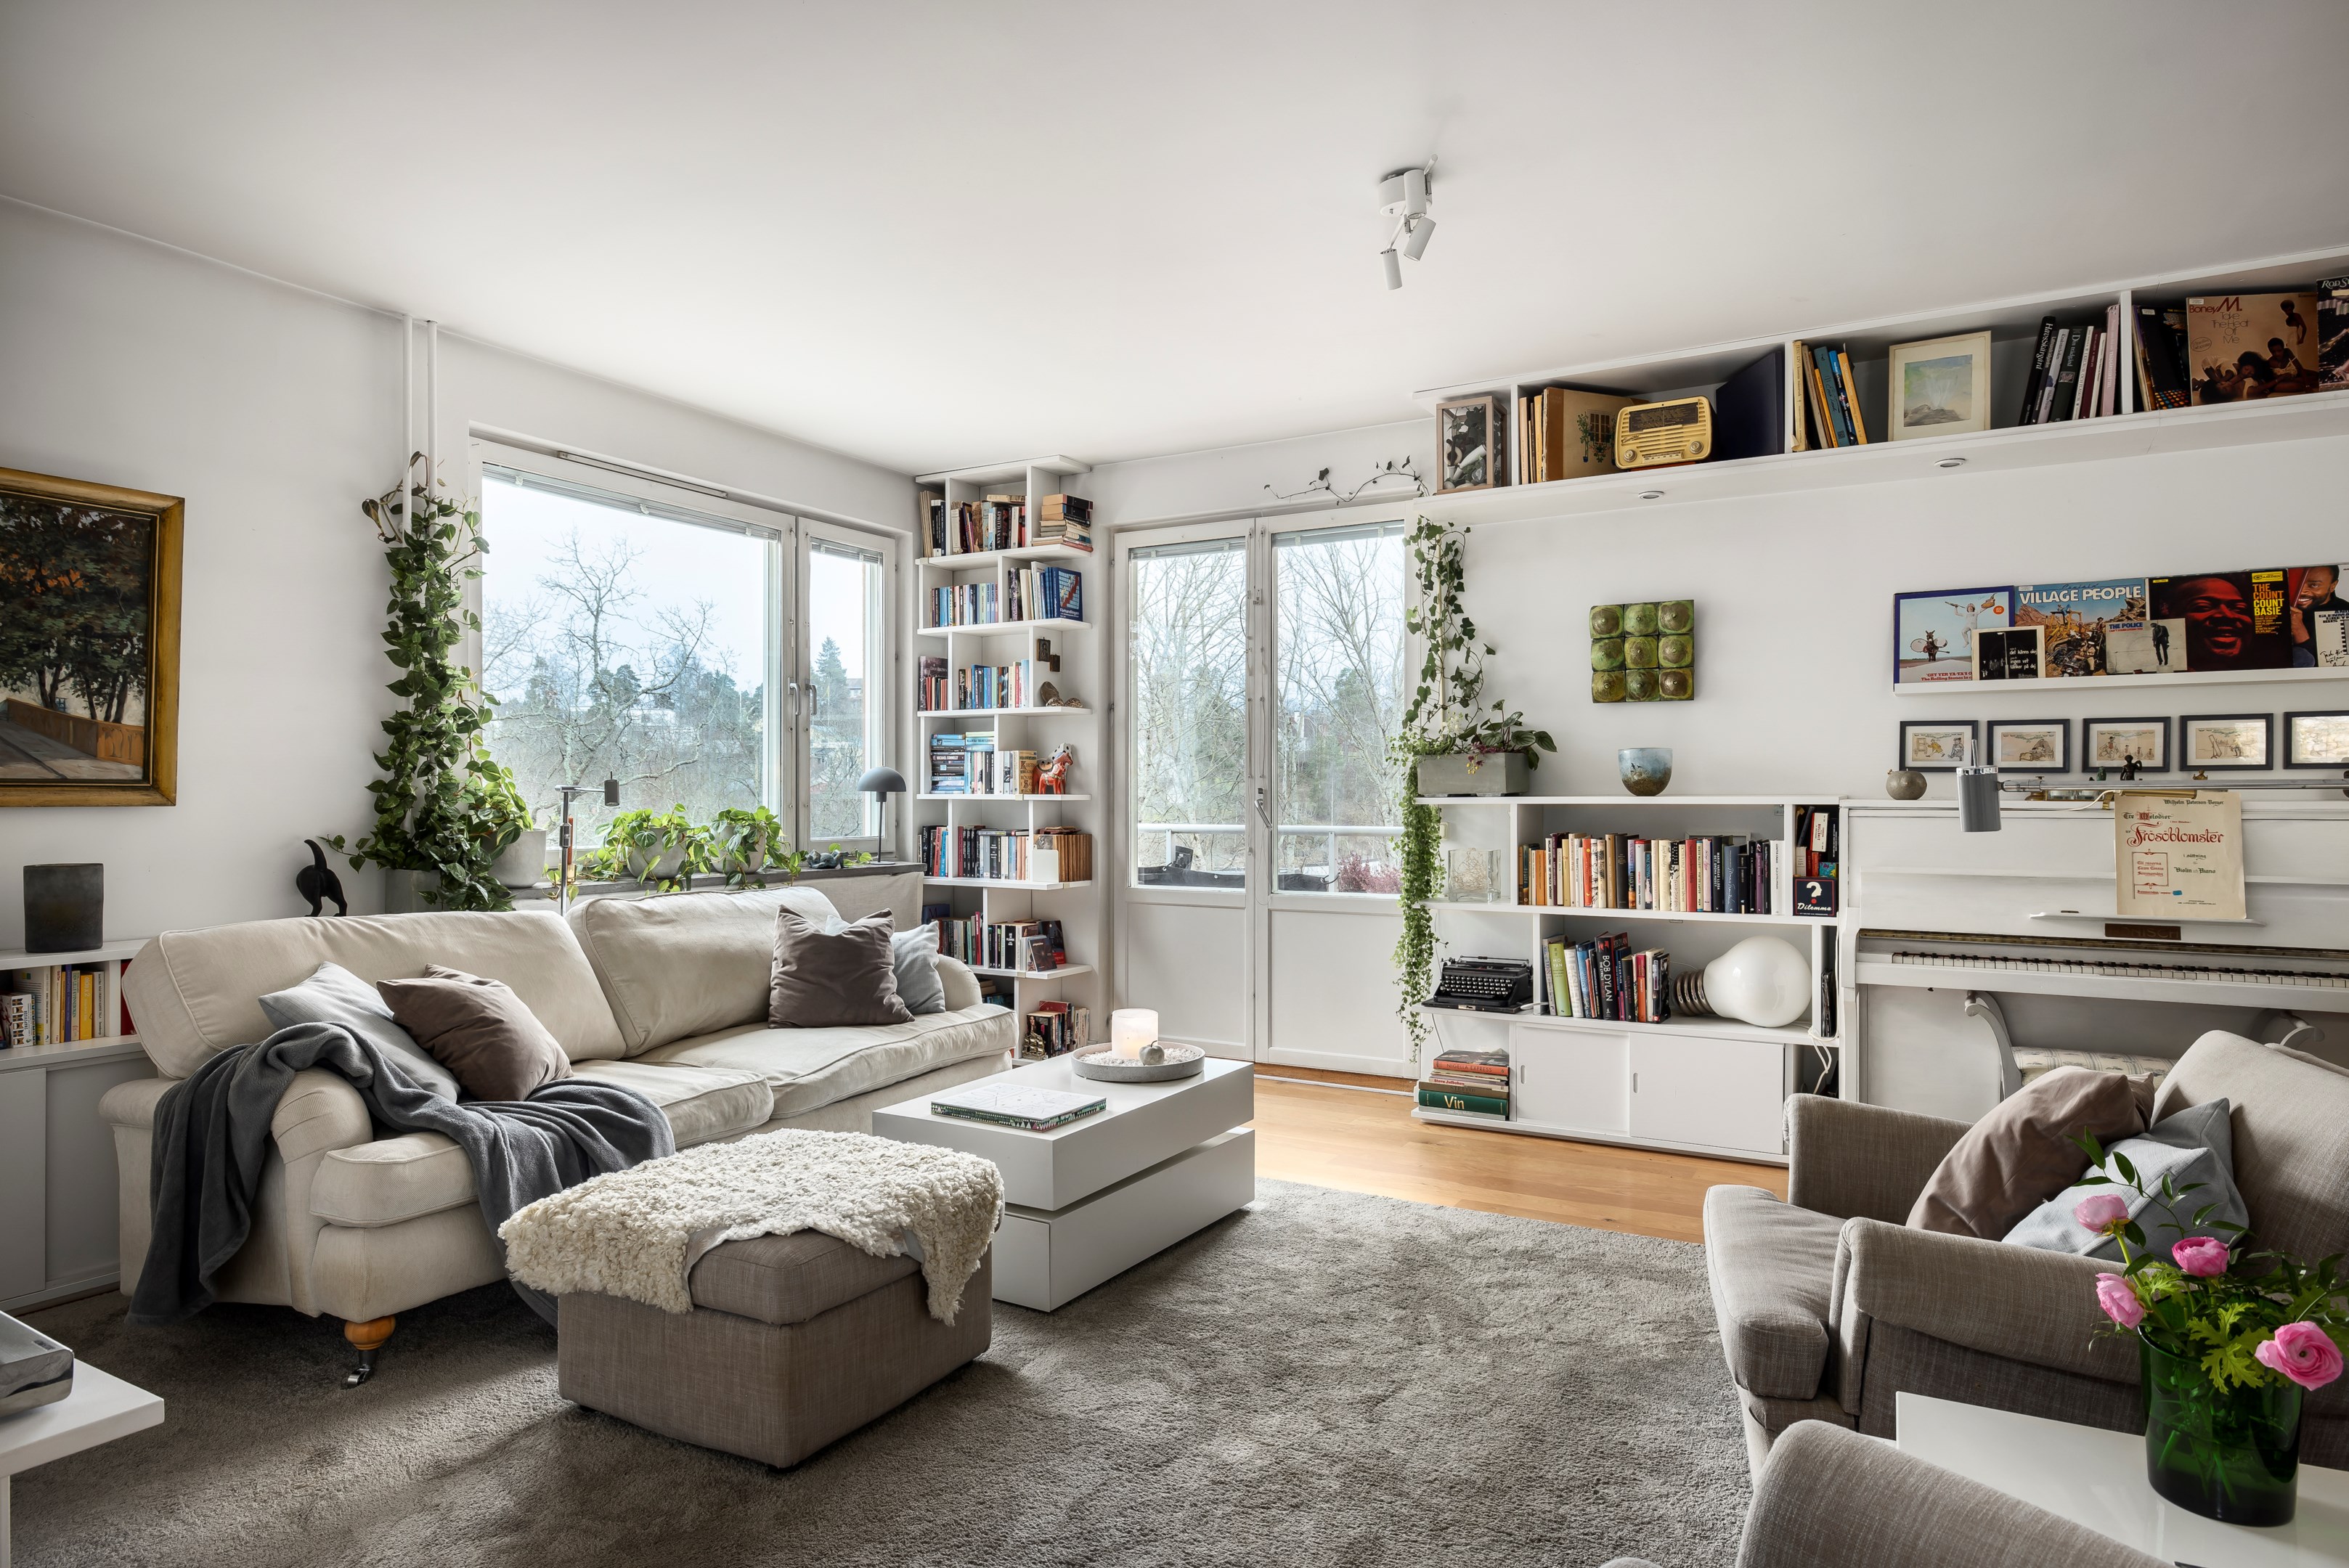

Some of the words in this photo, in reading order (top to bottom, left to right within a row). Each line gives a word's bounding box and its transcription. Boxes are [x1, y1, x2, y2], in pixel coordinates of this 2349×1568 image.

[2321, 280, 2341, 289] ROD
[2189, 305, 2218, 314] Boney
[2212, 319, 2226, 328] The
[2071, 334, 2081, 346] Din
[2067, 346, 2077, 367] trädgård
[2019, 589, 2078, 605] VILLAGE
[2083, 586, 2141, 601] PEOPLE
[2253, 591, 2284, 600] COUNT
[2254, 599, 2284, 608] COUNT
[2255, 607, 2281, 616] BASIE
[2137, 811, 2173, 820] Melodier
[2127, 822, 2224, 847] Frösöblomster
[1797, 902, 1832, 911] Dilemma
[1604, 974, 1613, 1001] DYLAN
[1444, 1095, 1465, 1109] Vin
